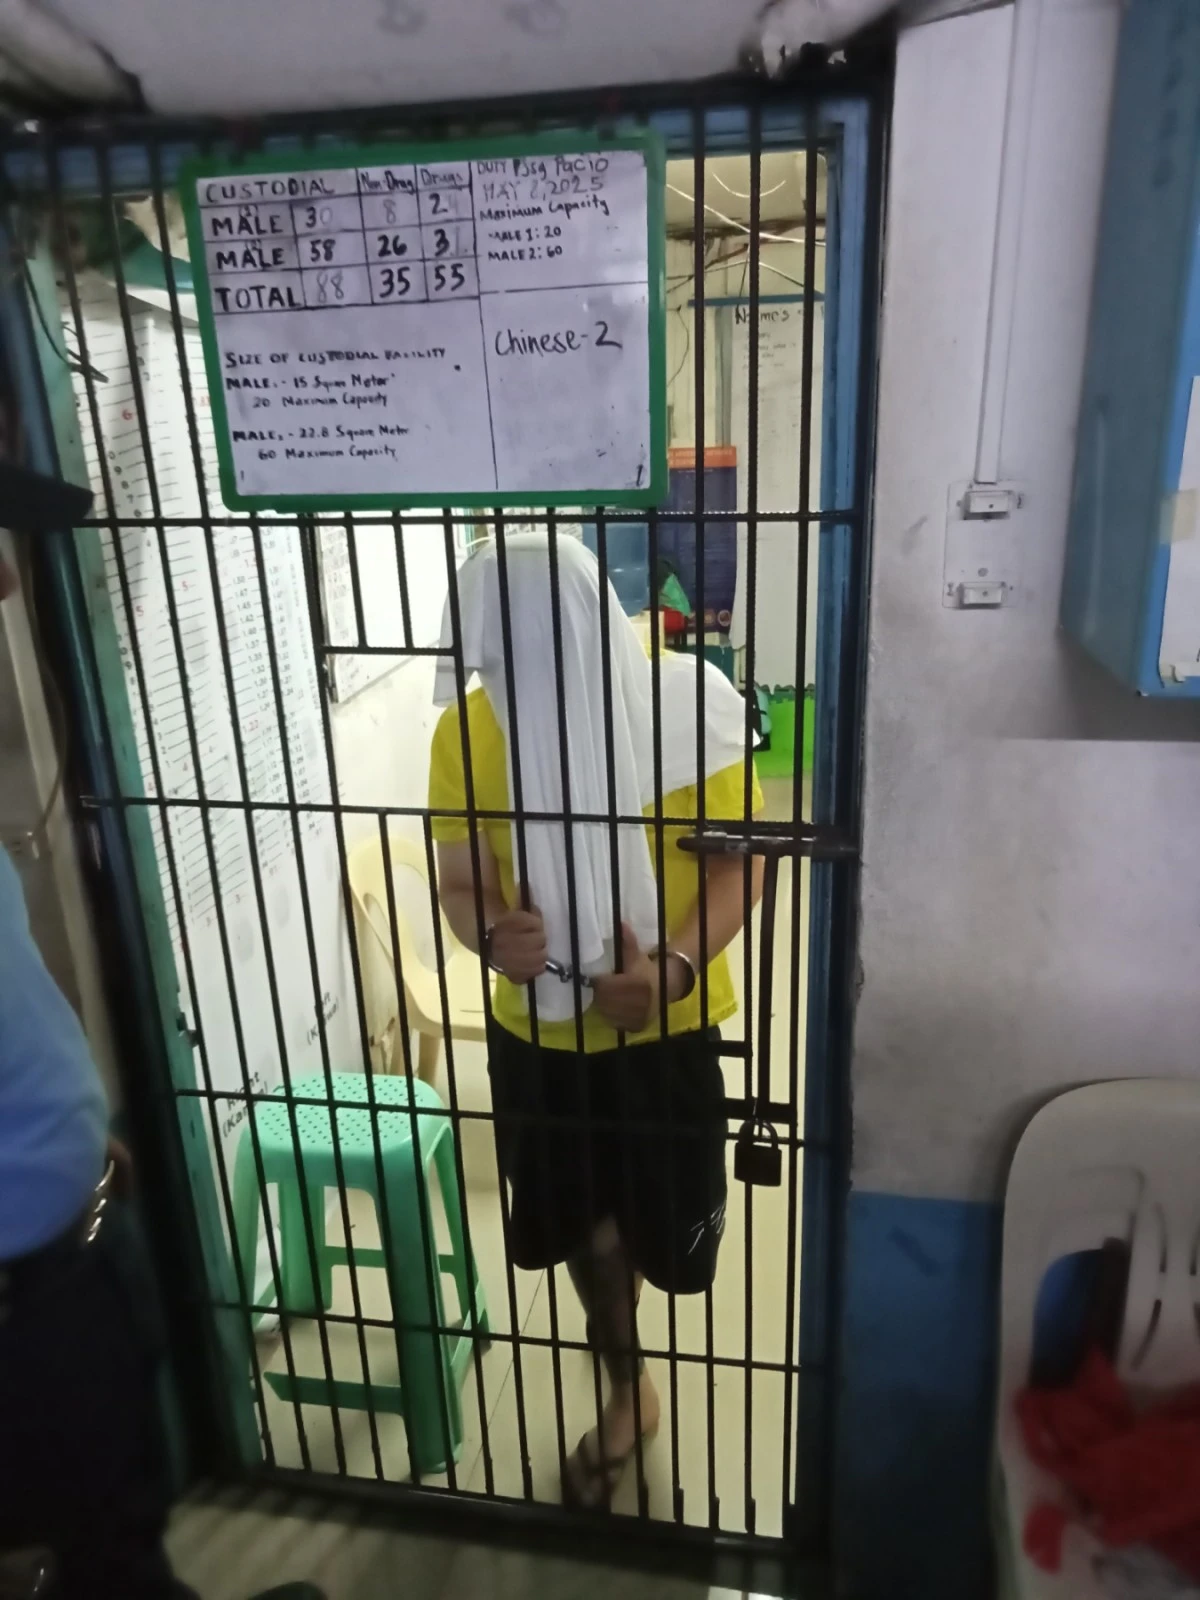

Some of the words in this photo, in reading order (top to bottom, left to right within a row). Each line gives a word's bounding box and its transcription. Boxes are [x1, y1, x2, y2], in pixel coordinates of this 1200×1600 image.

[206, 177, 335, 203] CUSTODIAL
[211, 214, 284, 237] MALE
[304, 205, 333, 229] 30
[543, 224, 562, 239] 20
[309, 238, 336, 262] 58
[377, 233, 408, 258] 26
[546, 245, 563, 259] 60
[215, 248, 285, 270] MALE
[315, 268, 345, 304] 88
[378, 265, 411, 299] 35
[434, 262, 466, 292] 55
[215, 285, 303, 312] TOTAL
[735, 303, 790, 325] Nme's
[225, 352, 262, 369] SIZE
[270, 352, 289, 364] OF
[293, 375, 309, 389] 15
[253, 396, 271, 409] 20
[257, 448, 277, 461] 60
